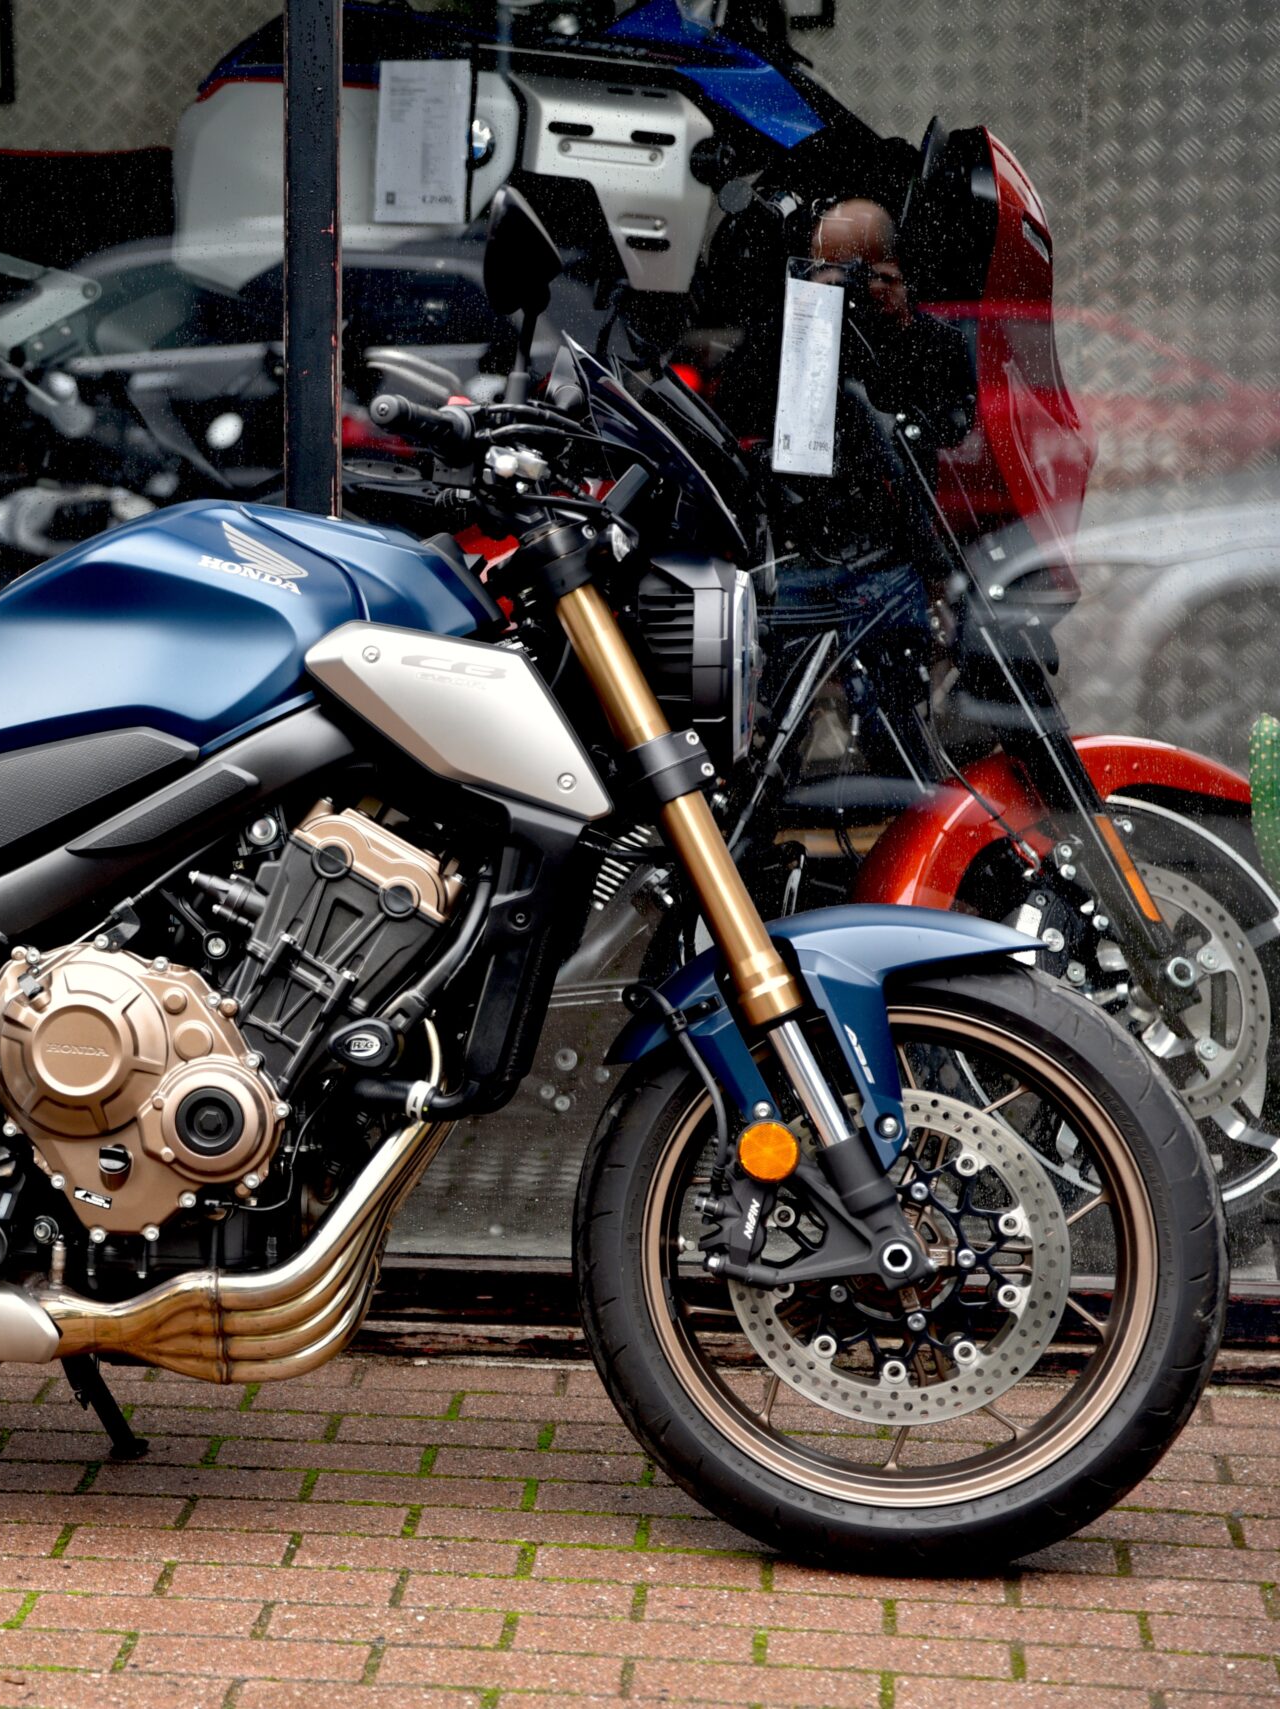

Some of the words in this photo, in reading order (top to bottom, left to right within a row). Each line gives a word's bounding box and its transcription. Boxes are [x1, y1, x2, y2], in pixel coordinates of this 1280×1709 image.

[198, 555, 302, 596] HONDA
[401, 655, 507, 679] CB
[46, 1042, 111, 1058] HONDA
[843, 1023, 875, 1085] ABS
